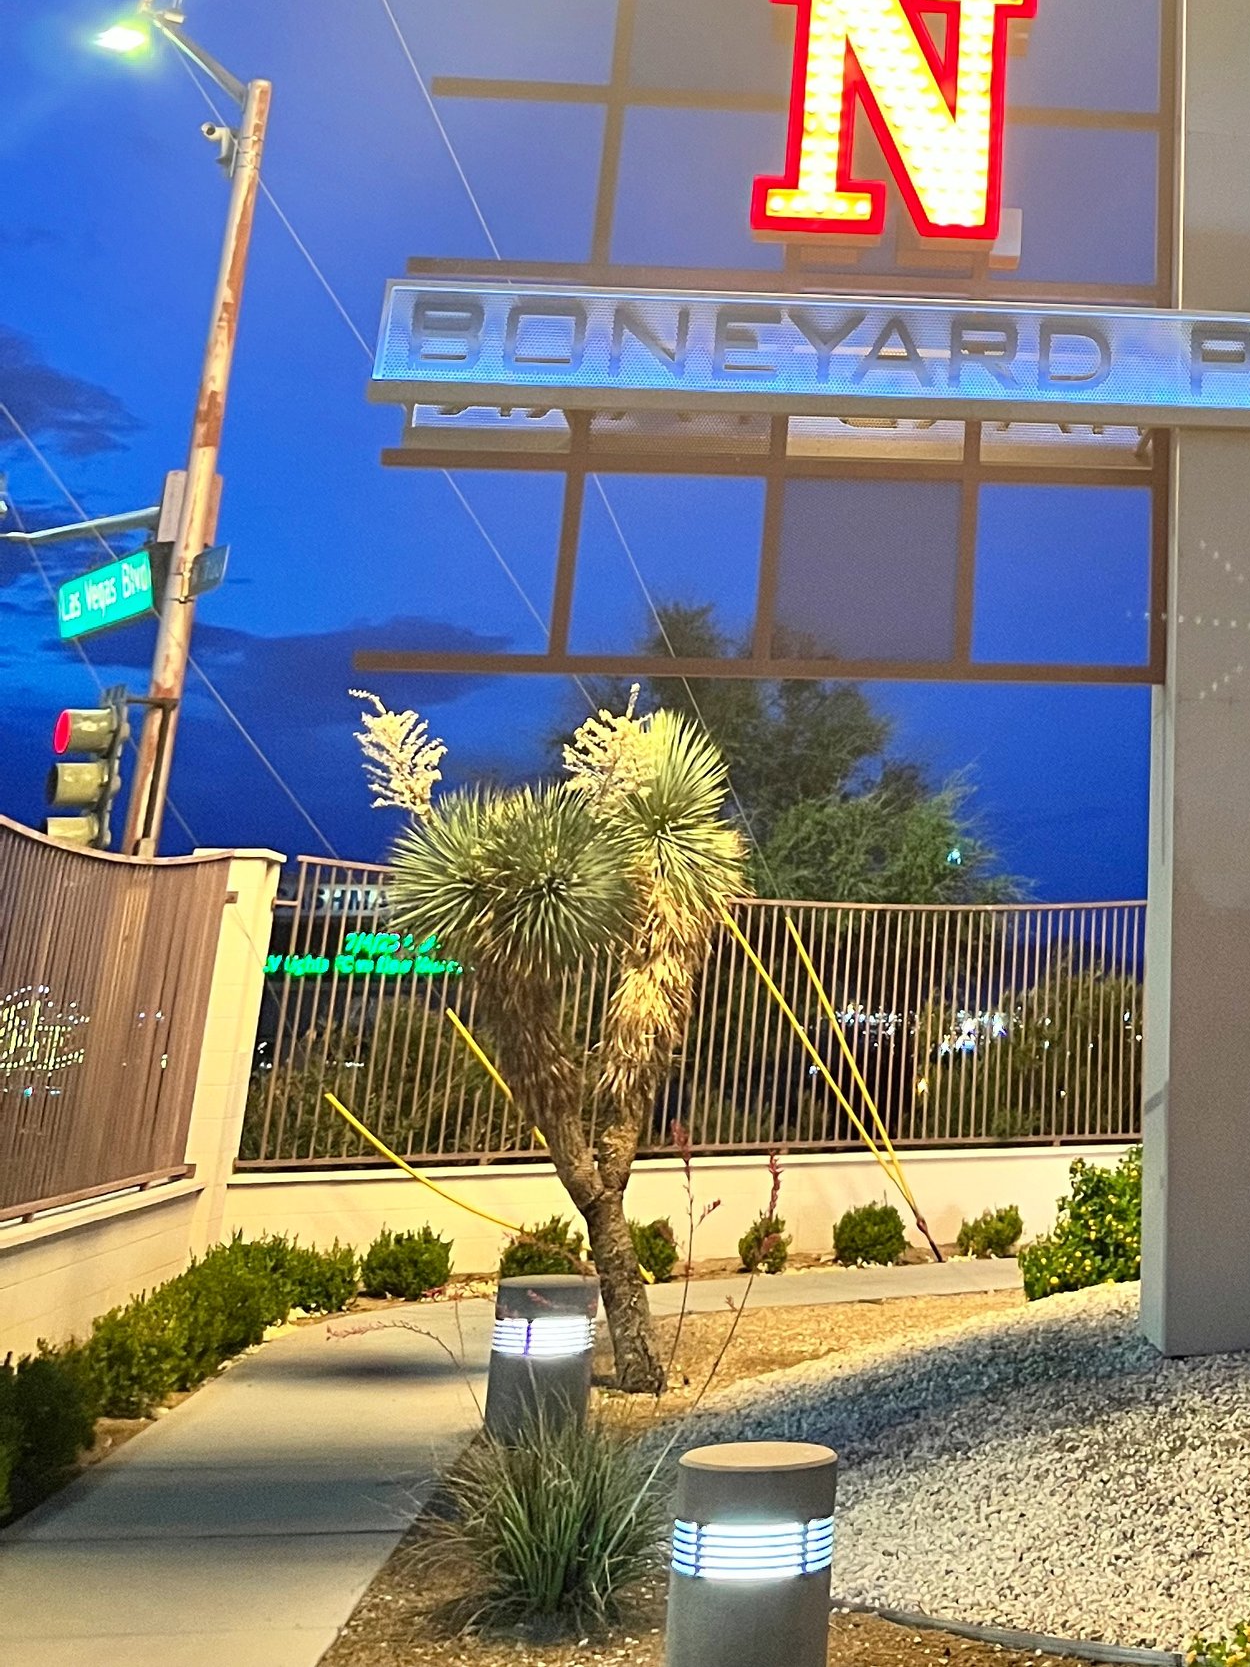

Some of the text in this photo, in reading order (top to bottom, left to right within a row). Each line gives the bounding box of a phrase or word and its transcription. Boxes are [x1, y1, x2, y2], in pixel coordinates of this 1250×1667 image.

[408, 294, 1112, 390] BONEYARD
[60, 589, 83, 622] Las
[84, 577, 117, 618] Vegas
[121, 562, 150, 600] Blvd
